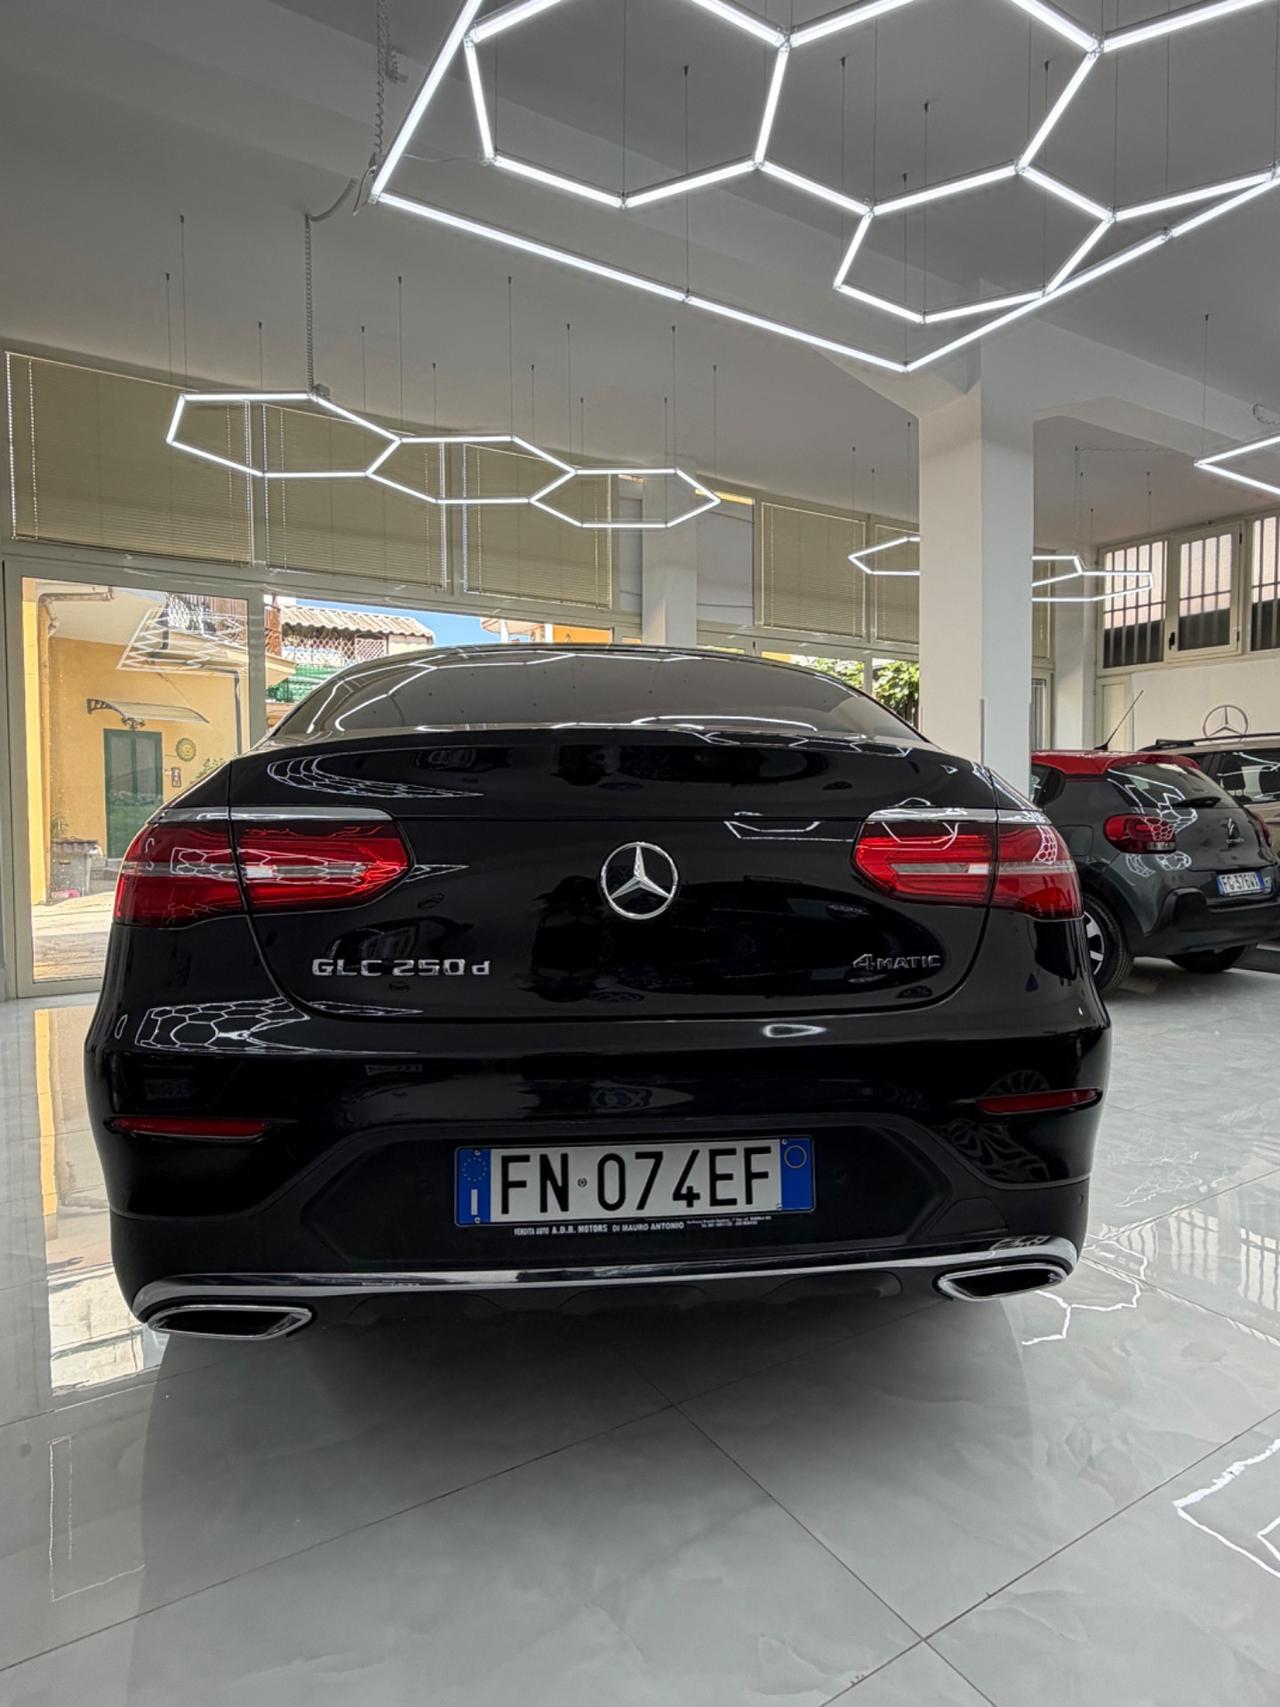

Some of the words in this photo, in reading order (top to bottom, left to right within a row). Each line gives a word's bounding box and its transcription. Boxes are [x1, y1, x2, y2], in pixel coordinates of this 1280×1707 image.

[312, 958, 382, 976] GLC
[501, 1153, 569, 1214] FN
[597, 1146, 772, 1212] 074EF
[578, 1224, 608, 1233] MOTORS
[612, 1224, 621, 1232] DI
[622, 1222, 649, 1232] MAURO
[650, 1221, 685, 1230] ANTONIO
